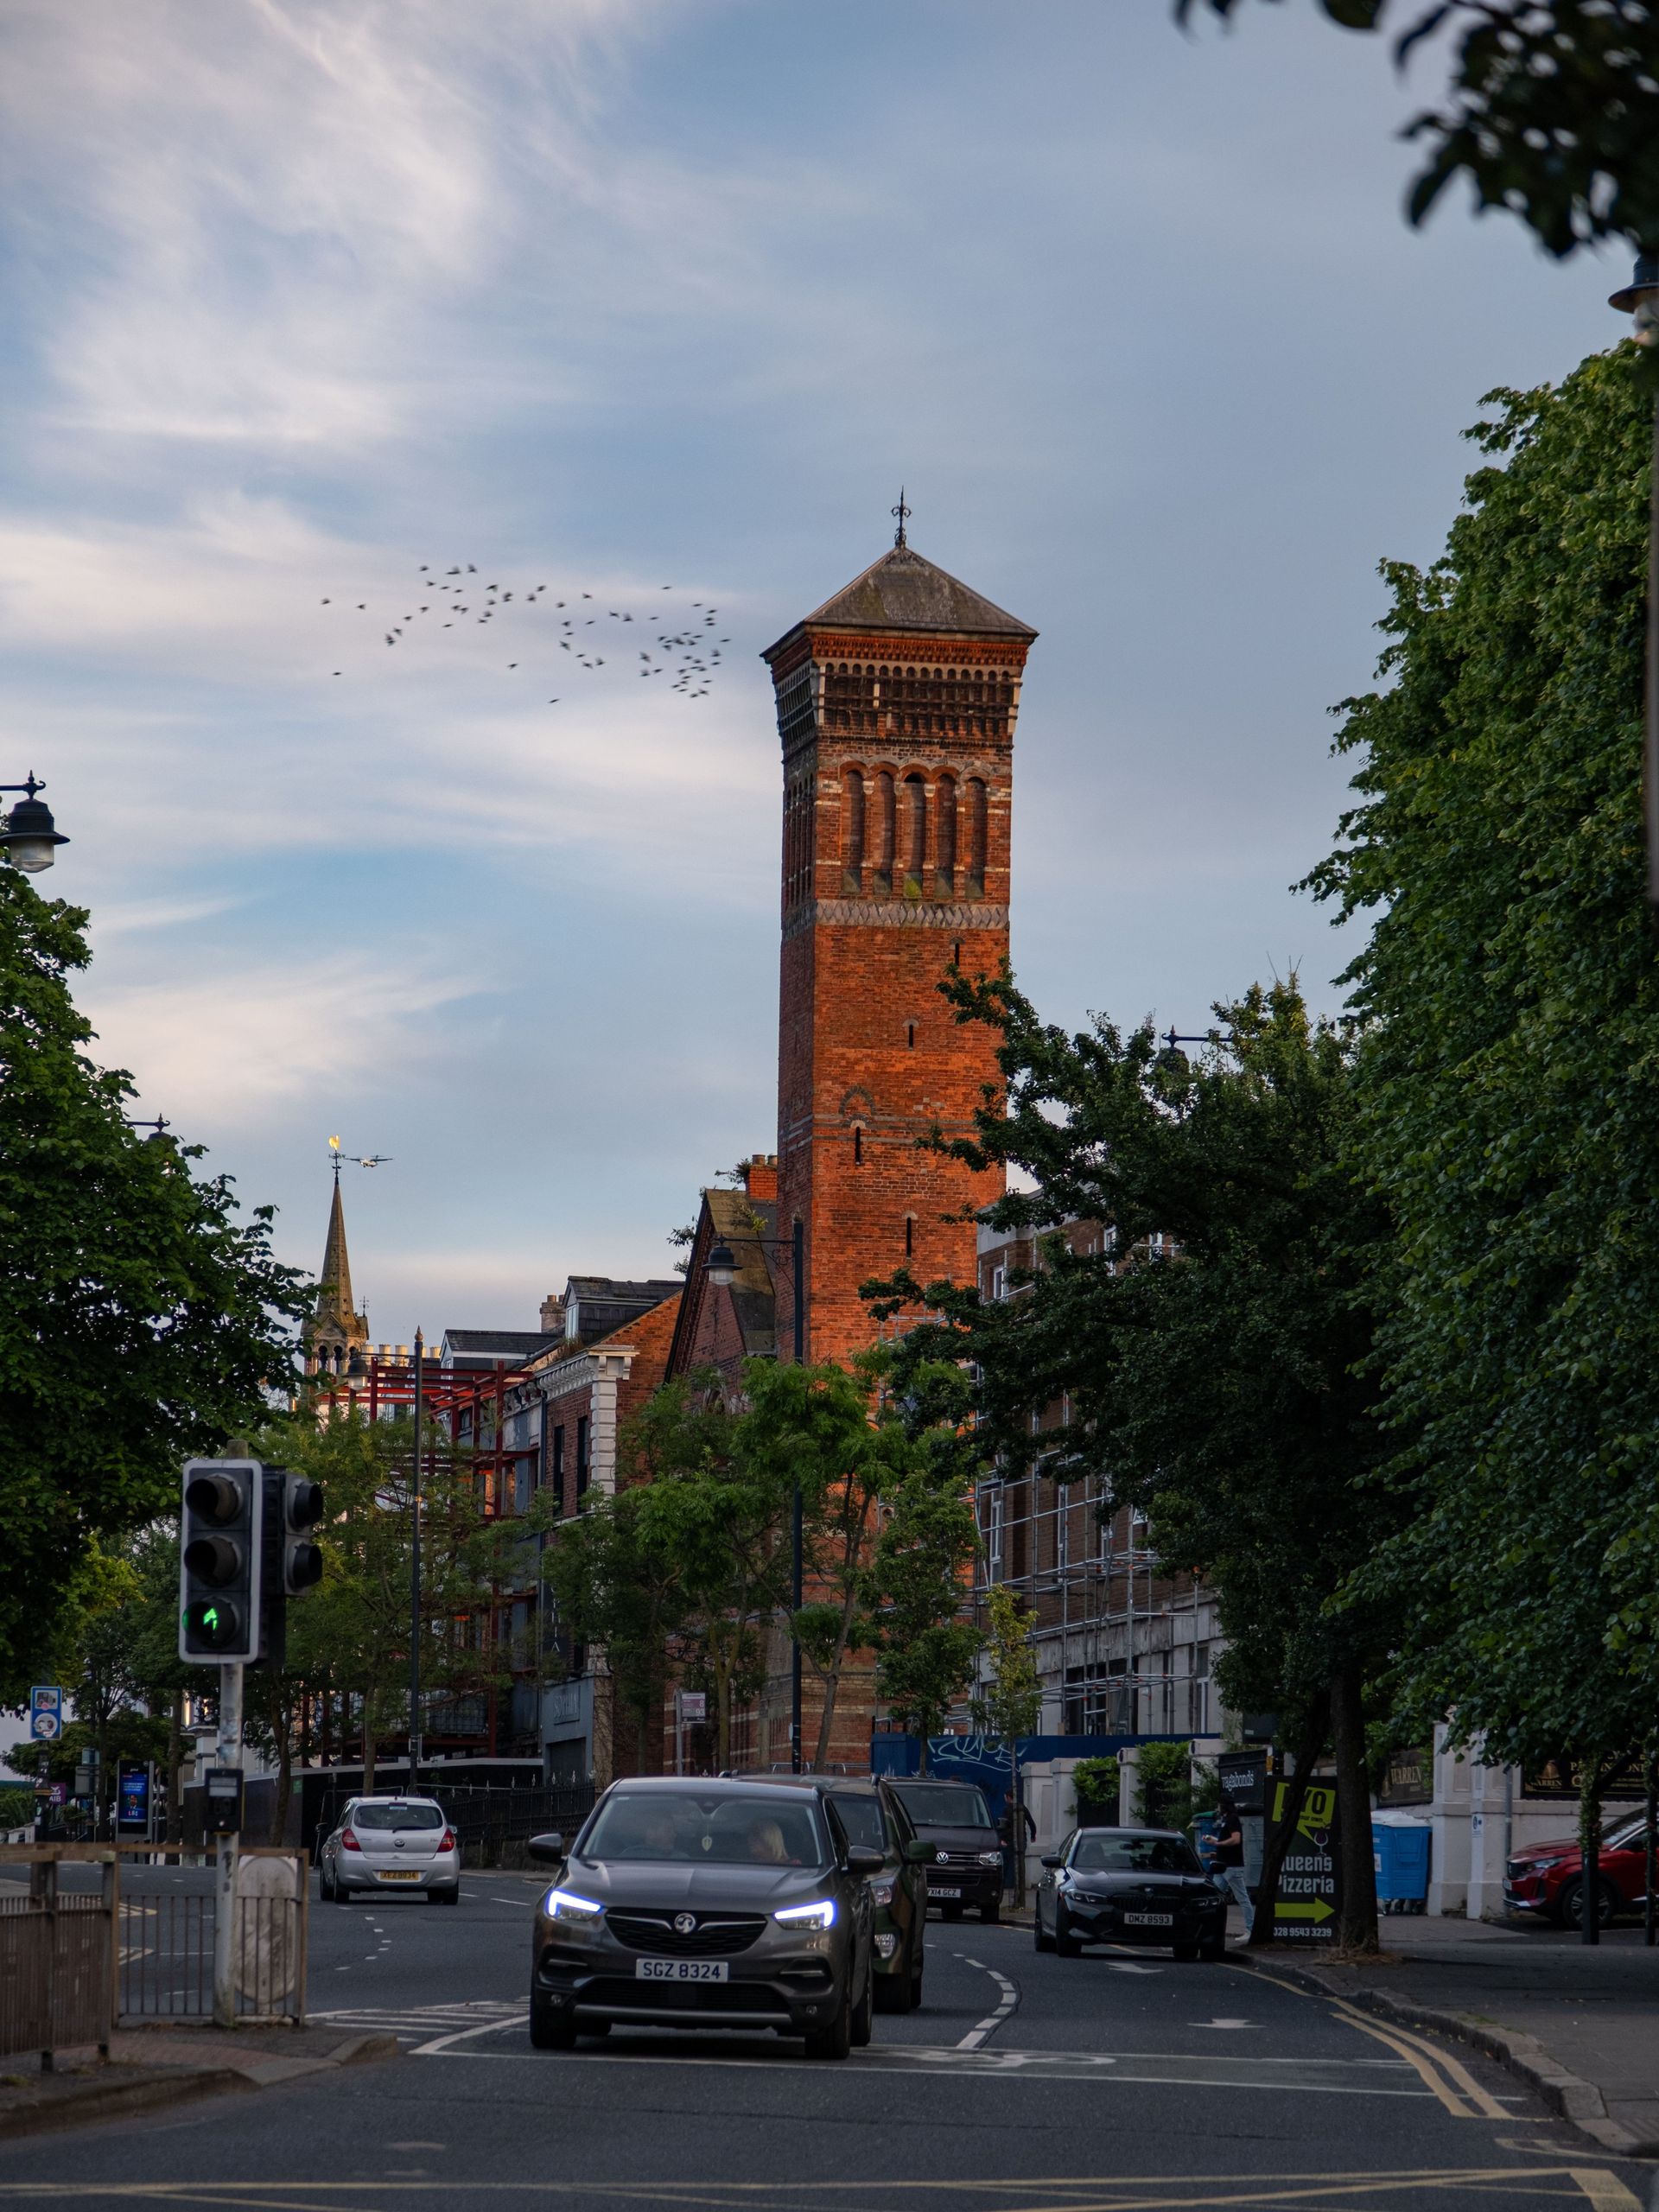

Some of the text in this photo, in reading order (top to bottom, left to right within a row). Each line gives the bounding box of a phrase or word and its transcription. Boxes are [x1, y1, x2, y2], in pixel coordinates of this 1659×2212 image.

[1147, 1915, 1169, 1924] 8593
[1289, 1927, 1310, 1937] 9543
[1311, 1928, 1332, 1937] 3239
[644, 1962, 720, 1980] SGZ 8324
